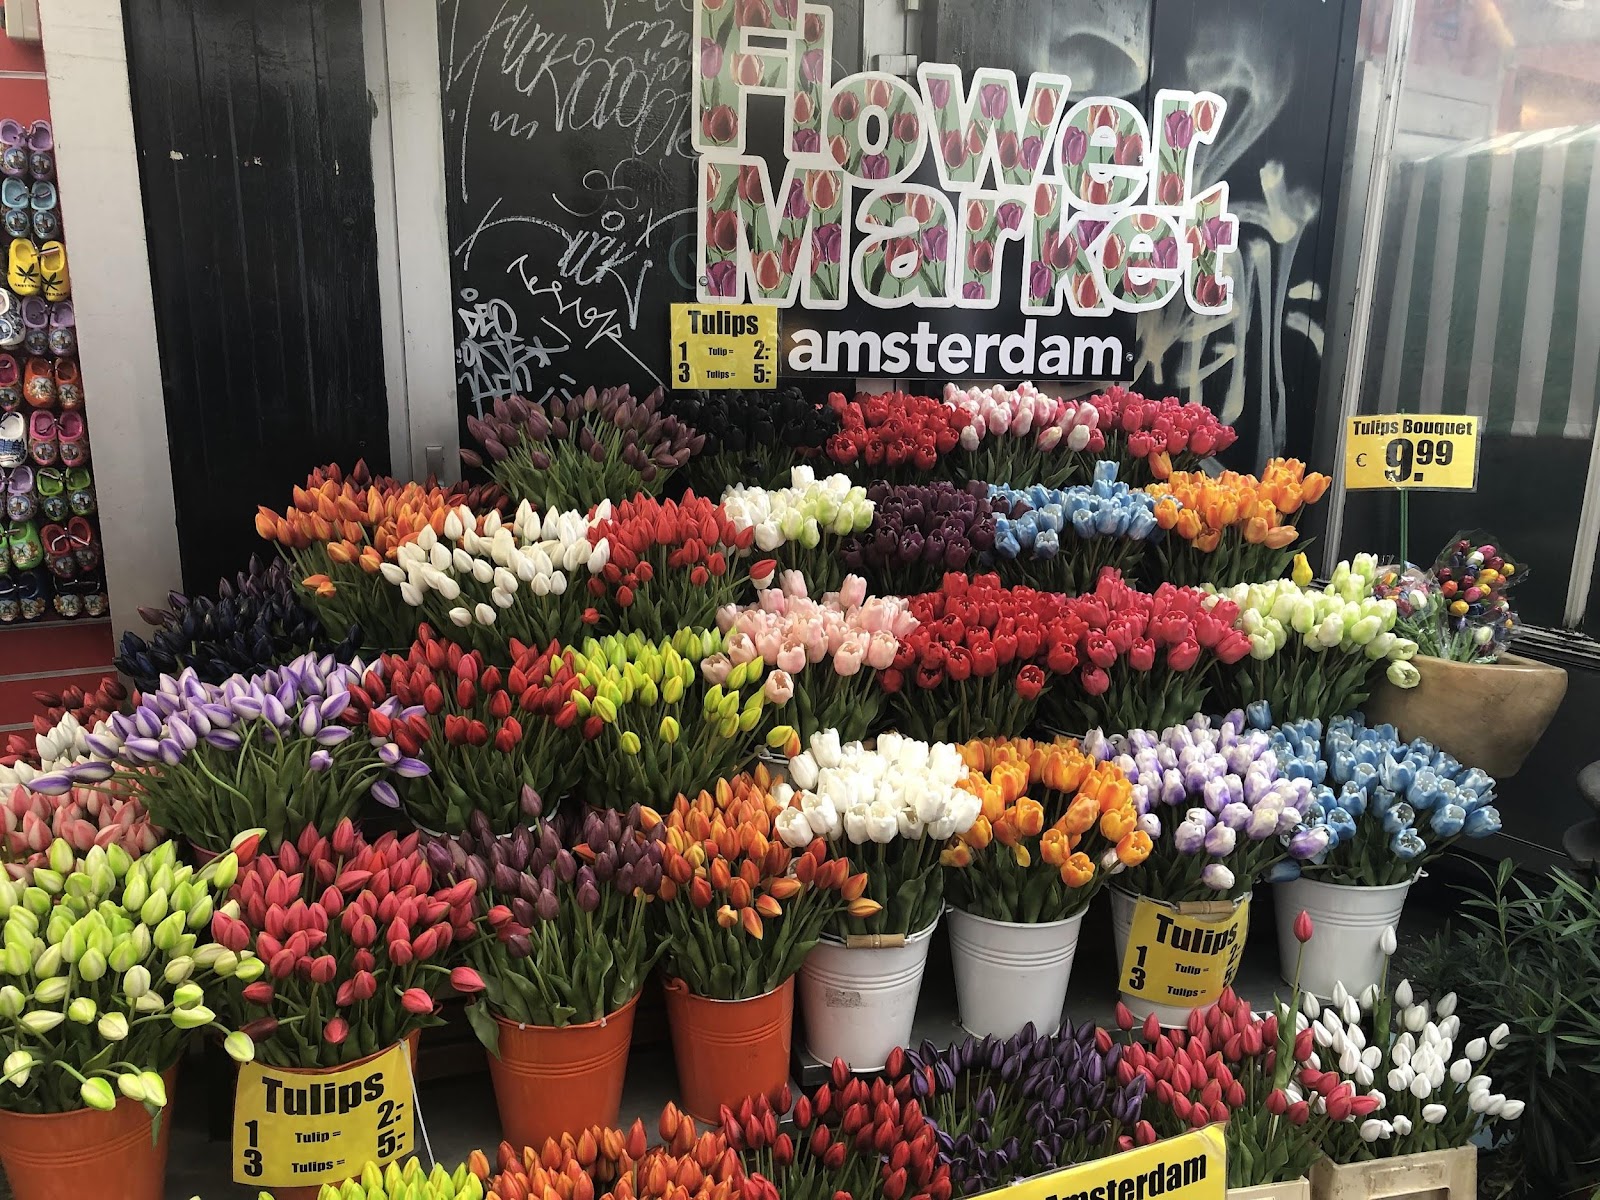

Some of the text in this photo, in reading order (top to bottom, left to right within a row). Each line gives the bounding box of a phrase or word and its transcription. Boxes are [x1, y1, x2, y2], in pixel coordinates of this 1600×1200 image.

[691, 0, 1227, 213] Flower
[697, 153, 1239, 316] Market
[687, 310, 759, 337] Tulips
[678, 341, 687, 361] 1
[708, 347, 728, 357] Tulip
[788, 318, 1123, 375] amsterdam
[678, 362, 690, 383] 3
[706, 370, 730, 379] Tulips
[1353, 419, 1473, 436] Tulips Bouquet
[1156, 913, 1239, 956] Tulips
[1136, 945, 1148, 968] 1
[1175, 962, 1202, 976] Tulip
[1129, 967, 1147, 991] 3
[1167, 985, 1199, 998] Tulips
[262, 1072, 385, 1116] Tulips
[244, 1119, 258, 1148] 1
[295, 1131, 330, 1144] Tulip
[243, 1148, 263, 1177] 3
[291, 1159, 334, 1173] Tulips
[1045, 1153, 1207, 1200] sterdam
